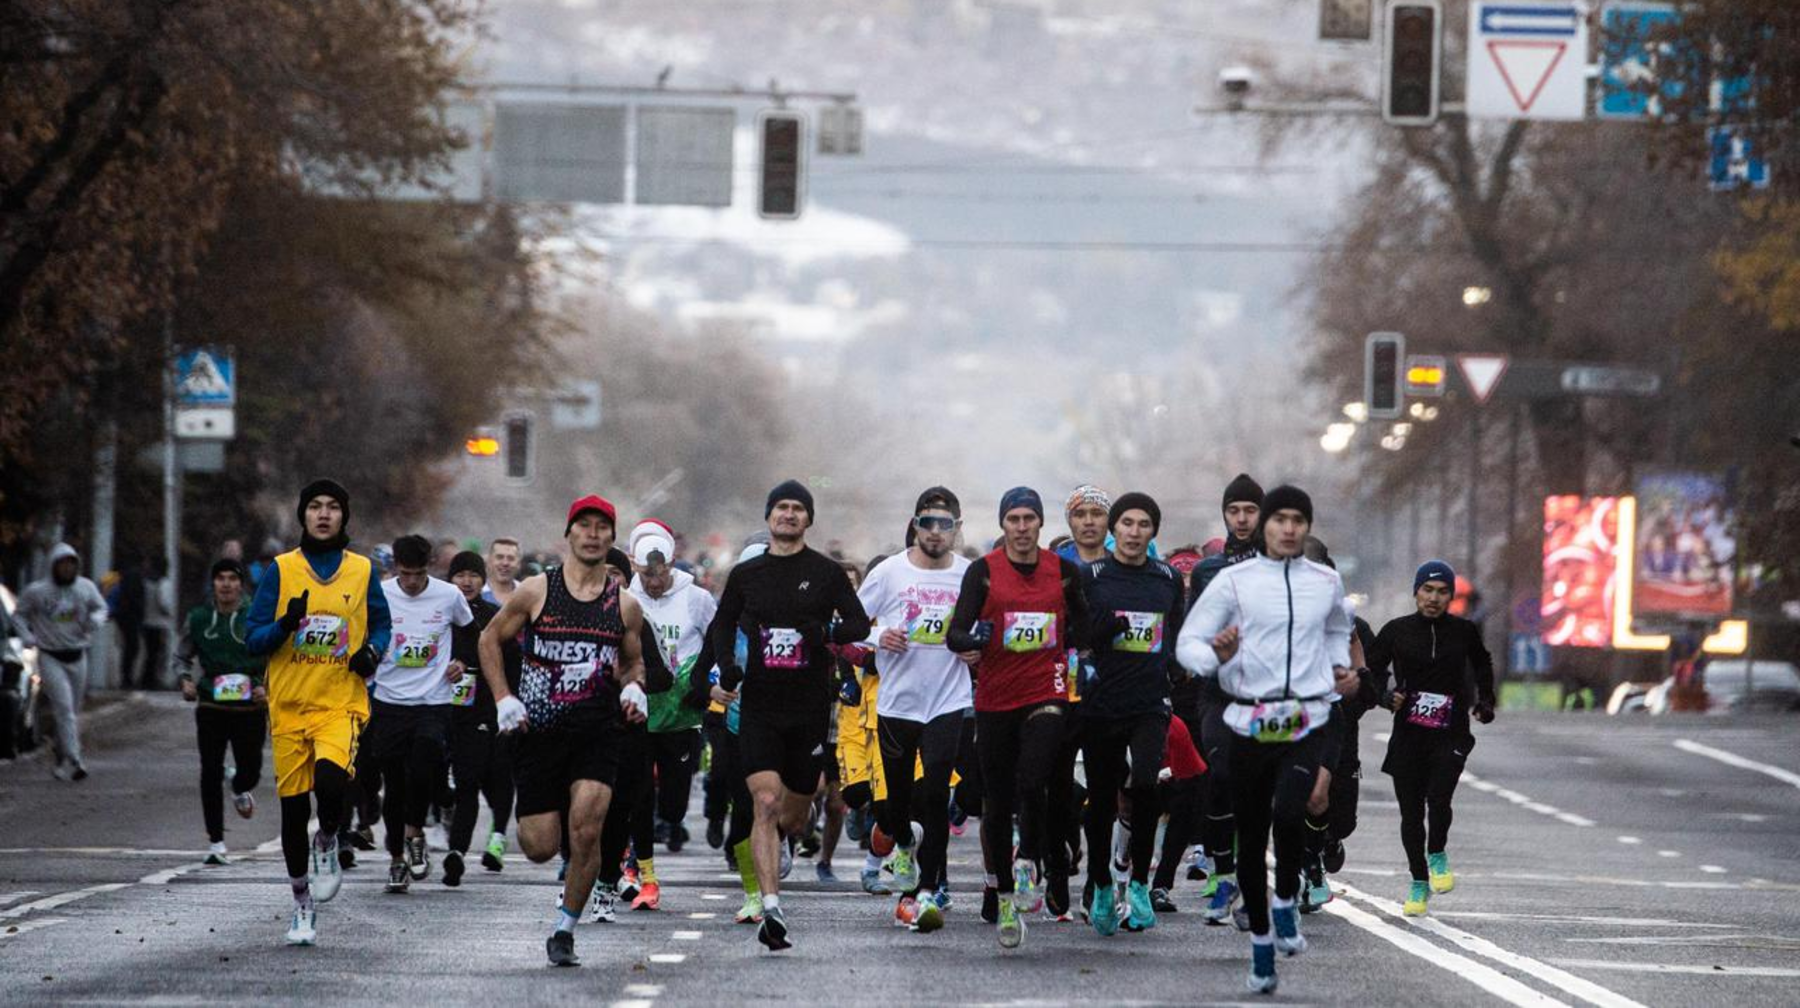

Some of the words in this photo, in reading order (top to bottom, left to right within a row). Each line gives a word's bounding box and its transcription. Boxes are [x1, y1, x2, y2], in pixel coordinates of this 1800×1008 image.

[924, 619, 943, 633] 79
[306, 631, 337, 646] 672
[1014, 627, 1043, 642] 791
[1125, 627, 1152, 641] 678
[291, 653, 350, 665] АРЫСТАН
[404, 646, 430, 659] 218
